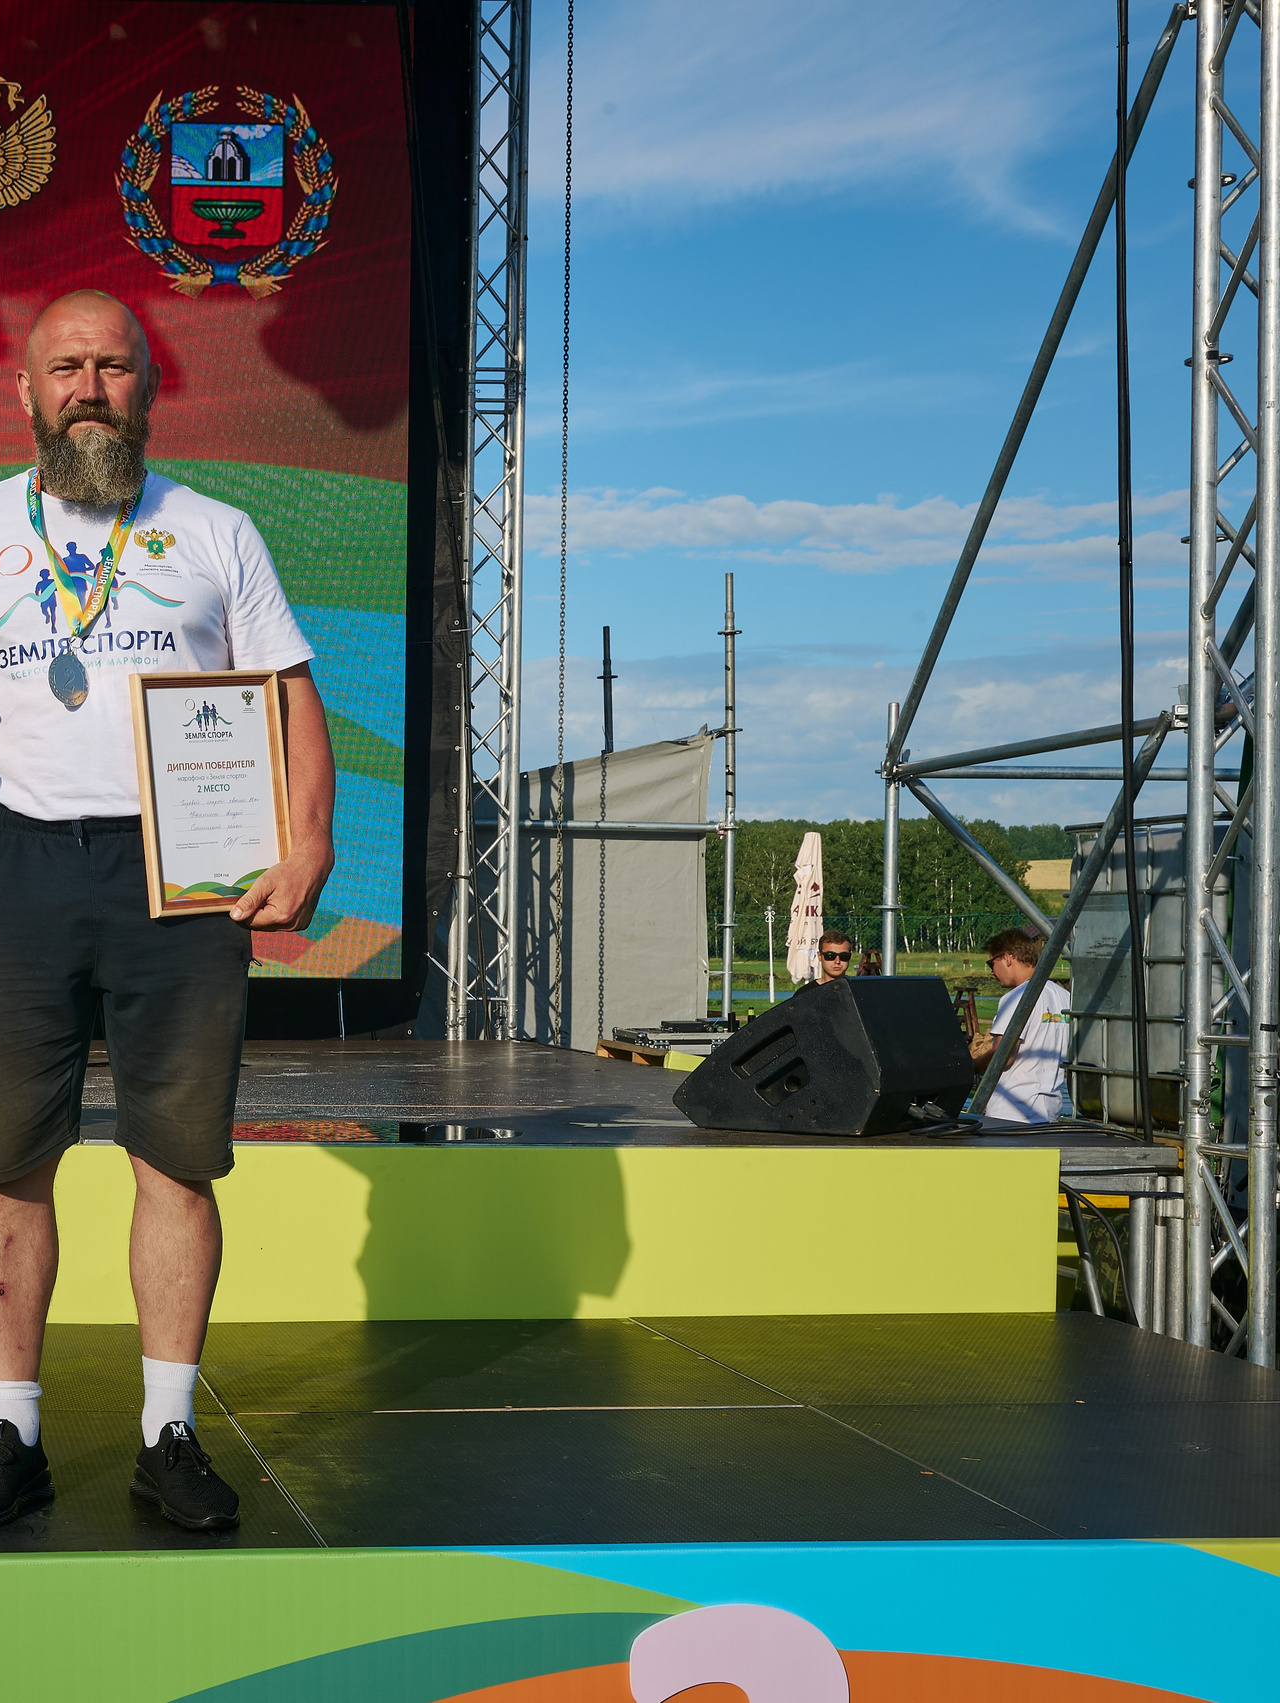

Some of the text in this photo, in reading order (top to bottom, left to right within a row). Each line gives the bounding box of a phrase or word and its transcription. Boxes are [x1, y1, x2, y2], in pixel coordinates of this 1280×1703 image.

[86, 556, 115, 621] ЗЕМЛЯ СПОРТА
[80, 630, 176, 654] СПОРТА
[10, 656, 159, 681] ВСЕРОСКИЙ МАРАФОН
[62, 667, 76, 694] 2
[184, 731, 233, 740] ЗЕМЛЯ СПОРТА
[166, 760, 256, 773] ДИПЛОМ ПОБЕДИТЕЛЯ
[197, 783, 231, 793] 2 МЕСТО
[170, 1422, 188, 1437] M
